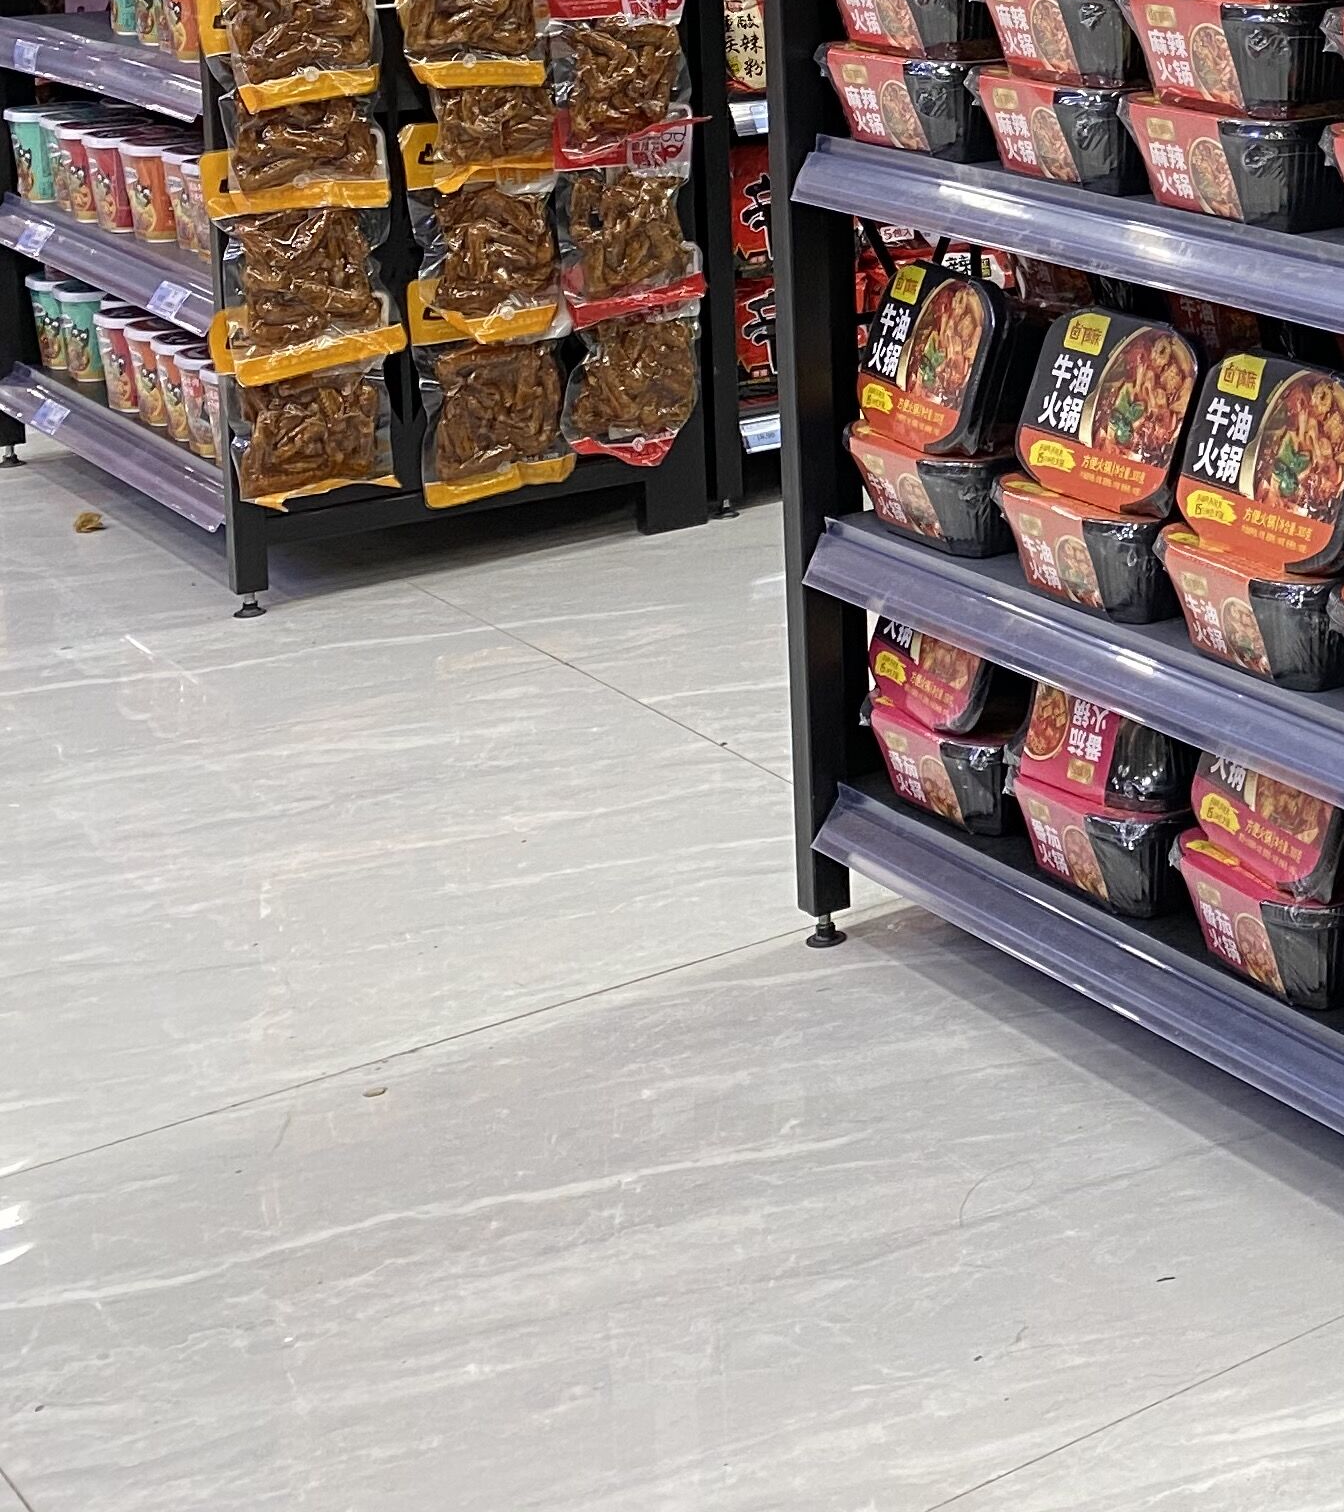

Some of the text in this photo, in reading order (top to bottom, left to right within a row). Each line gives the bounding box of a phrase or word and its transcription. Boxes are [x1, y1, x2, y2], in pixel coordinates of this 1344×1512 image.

[850, 10, 882, 36] 火锅
[995, 4, 1029, 31] 麻辣
[1004, 32, 1037, 59] 火锅
[1147, 29, 1187, 58] 麻辣
[1156, 59, 1195, 87] 火锅
[846, 86, 878, 111] 麻辣
[853, 110, 885, 137] 火锅
[994, 110, 1029, 138] 麻辣
[1003, 139, 1037, 166] 火锅
[1149, 142, 1187, 171] 麻辣
[1156, 170, 1194, 199] 火锅
[880, 303, 910, 340] 牛油
[868, 338, 901, 379] 火锅
[1052, 353, 1094, 395] 牛油
[1037, 391, 1084, 433] 火锅
[1204, 397, 1254, 444] 牛油
[1193, 439, 1243, 483] 火锅
